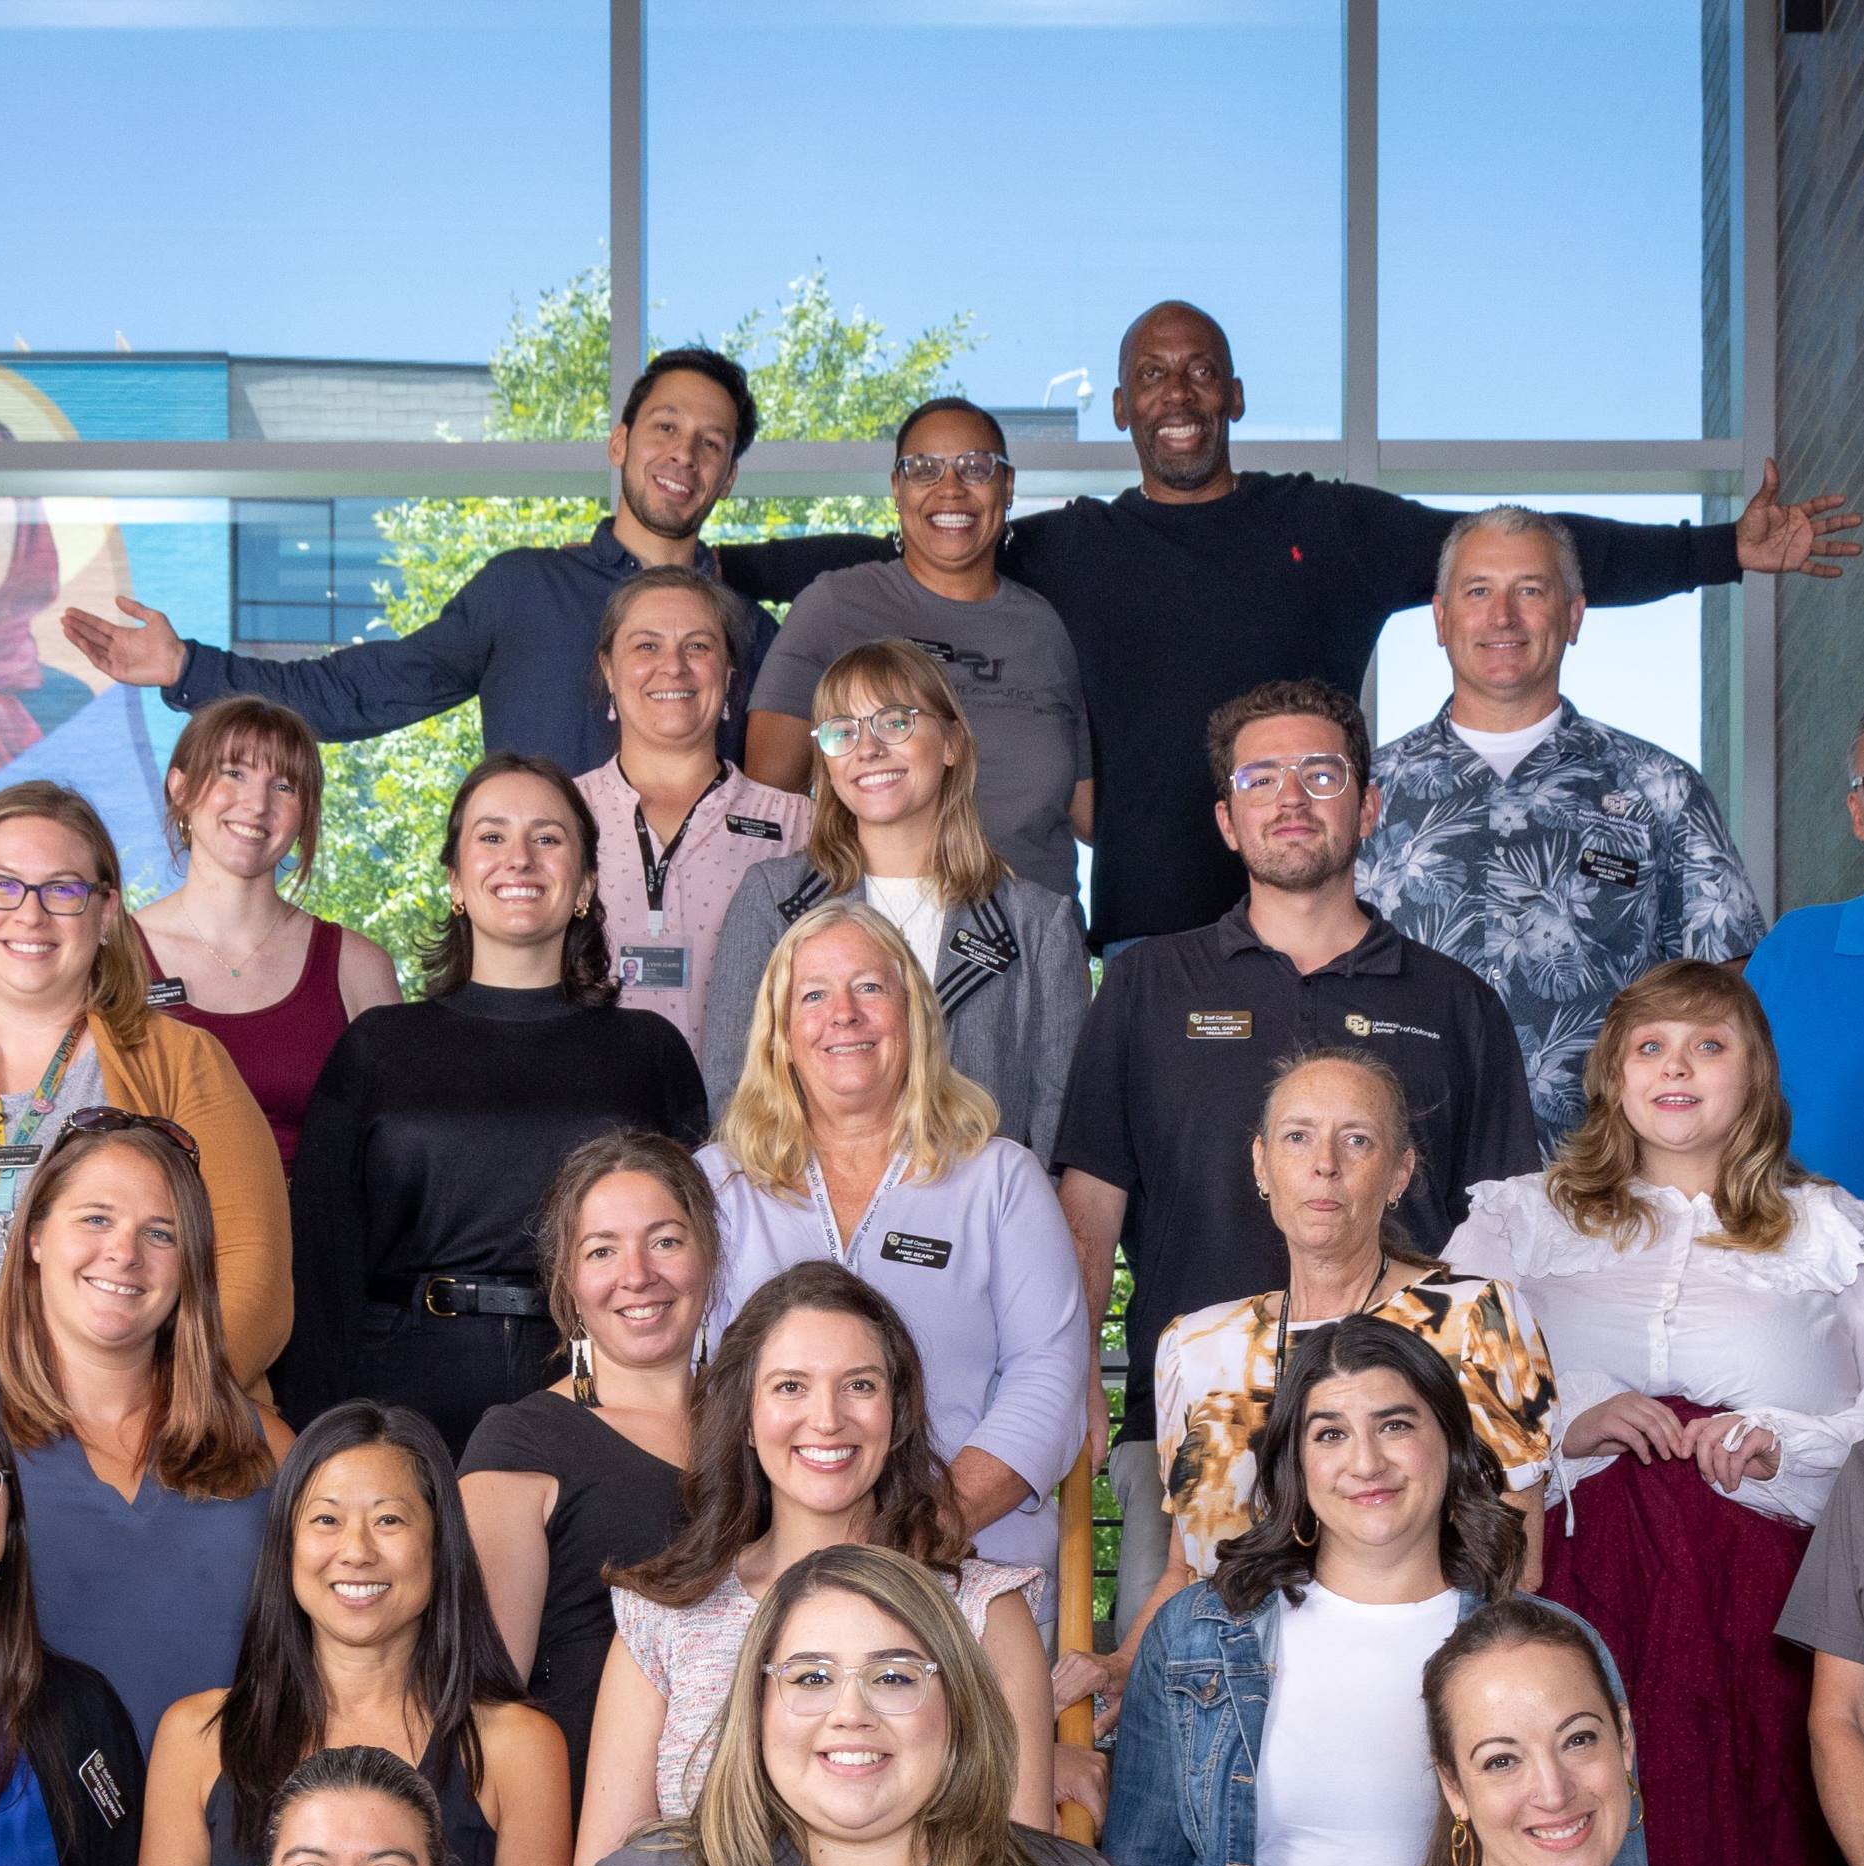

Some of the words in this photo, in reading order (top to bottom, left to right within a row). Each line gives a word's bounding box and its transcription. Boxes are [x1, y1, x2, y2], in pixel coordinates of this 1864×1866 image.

[1591, 866, 1607, 875] DAVID
[1345, 1014, 1371, 1037] CU
[1411, 1027, 1441, 1040] Colorado
[887, 1233, 902, 1246] CU
[913, 1240, 933, 1248] Council
[895, 1248, 914, 1256] ANNE
[913, 1252, 935, 1260] BEARD
